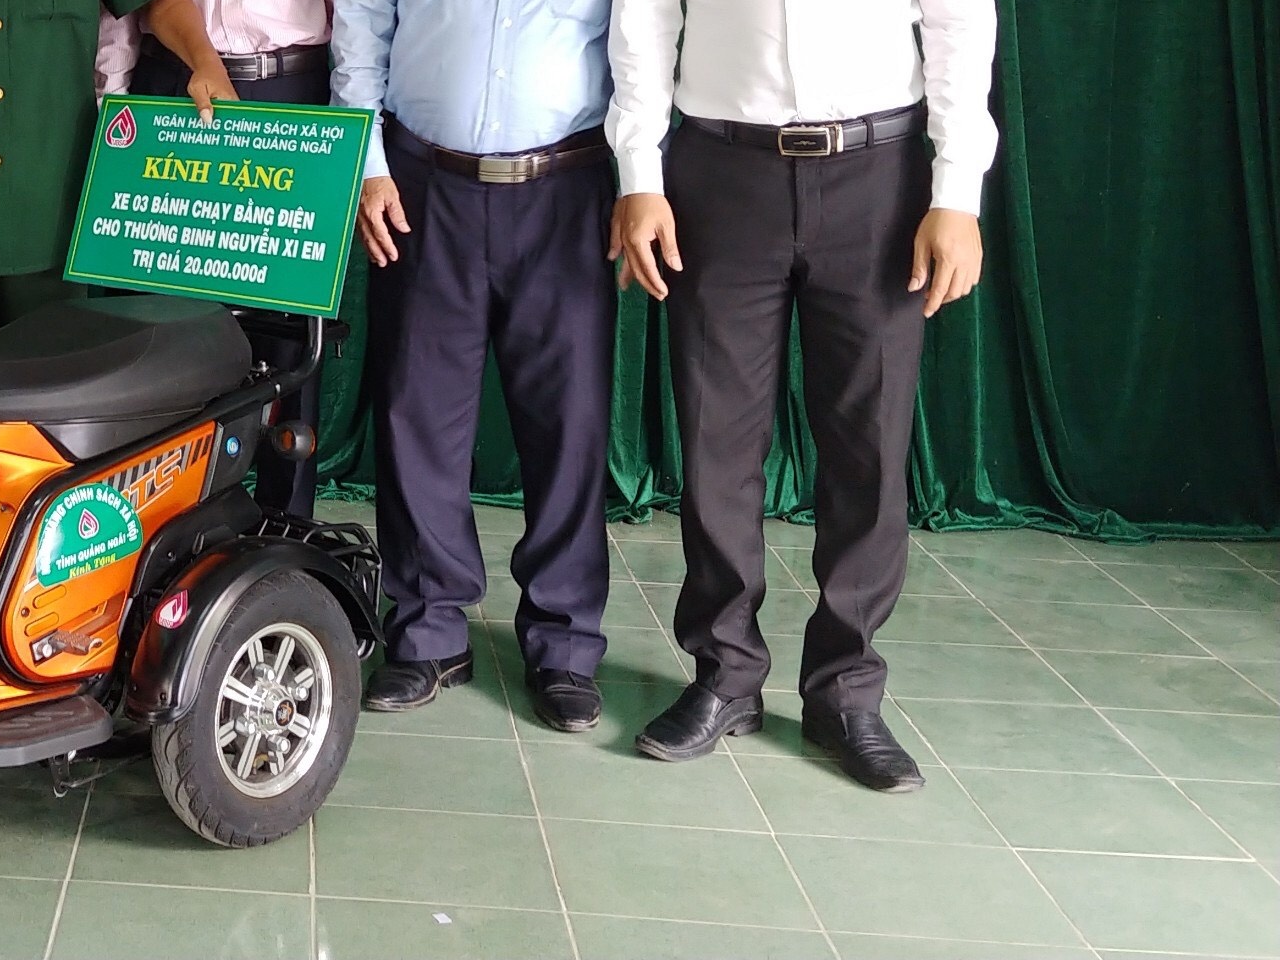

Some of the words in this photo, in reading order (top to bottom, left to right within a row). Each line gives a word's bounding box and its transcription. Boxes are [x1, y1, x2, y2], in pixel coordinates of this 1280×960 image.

[153, 114, 186, 128] NGÂN
[224, 117, 261, 133] CHÍNH
[263, 120, 298, 136] SÁCH
[300, 123, 317, 138] XÃ
[321, 126, 344, 141] HỘI
[157, 130, 177, 142] CHI
[179, 131, 220, 145] NHÁNH
[252, 136, 297, 152] QUẢNG
[300, 139, 332, 154] NGÃI
[142, 152, 212, 183] KÍNH
[218, 159, 294, 192] TẶNG
[111, 192, 131, 210] XE
[133, 194, 149, 212] 03
[151, 193, 189, 216] BÁNH
[192, 199, 232, 225] CHẠY
[234, 198, 275, 226] BẰNG
[278, 204, 315, 233] ĐIỆN
[93, 217, 120, 236] CHO
[123, 219, 177, 242] THƯƠNG
[180, 226, 216, 248] BINH
[218, 225, 280, 256] NGUYỄN
[281, 238, 298, 257] XI
[301, 240, 326, 261] EM
[132, 249, 155, 273] TRỊ
[156, 250, 181, 272] GIÁ
[183, 256, 268, 284] 20.000.000đ
[64, 487, 94, 509] CHÍNH
[96, 487, 121, 510] SÁCH
